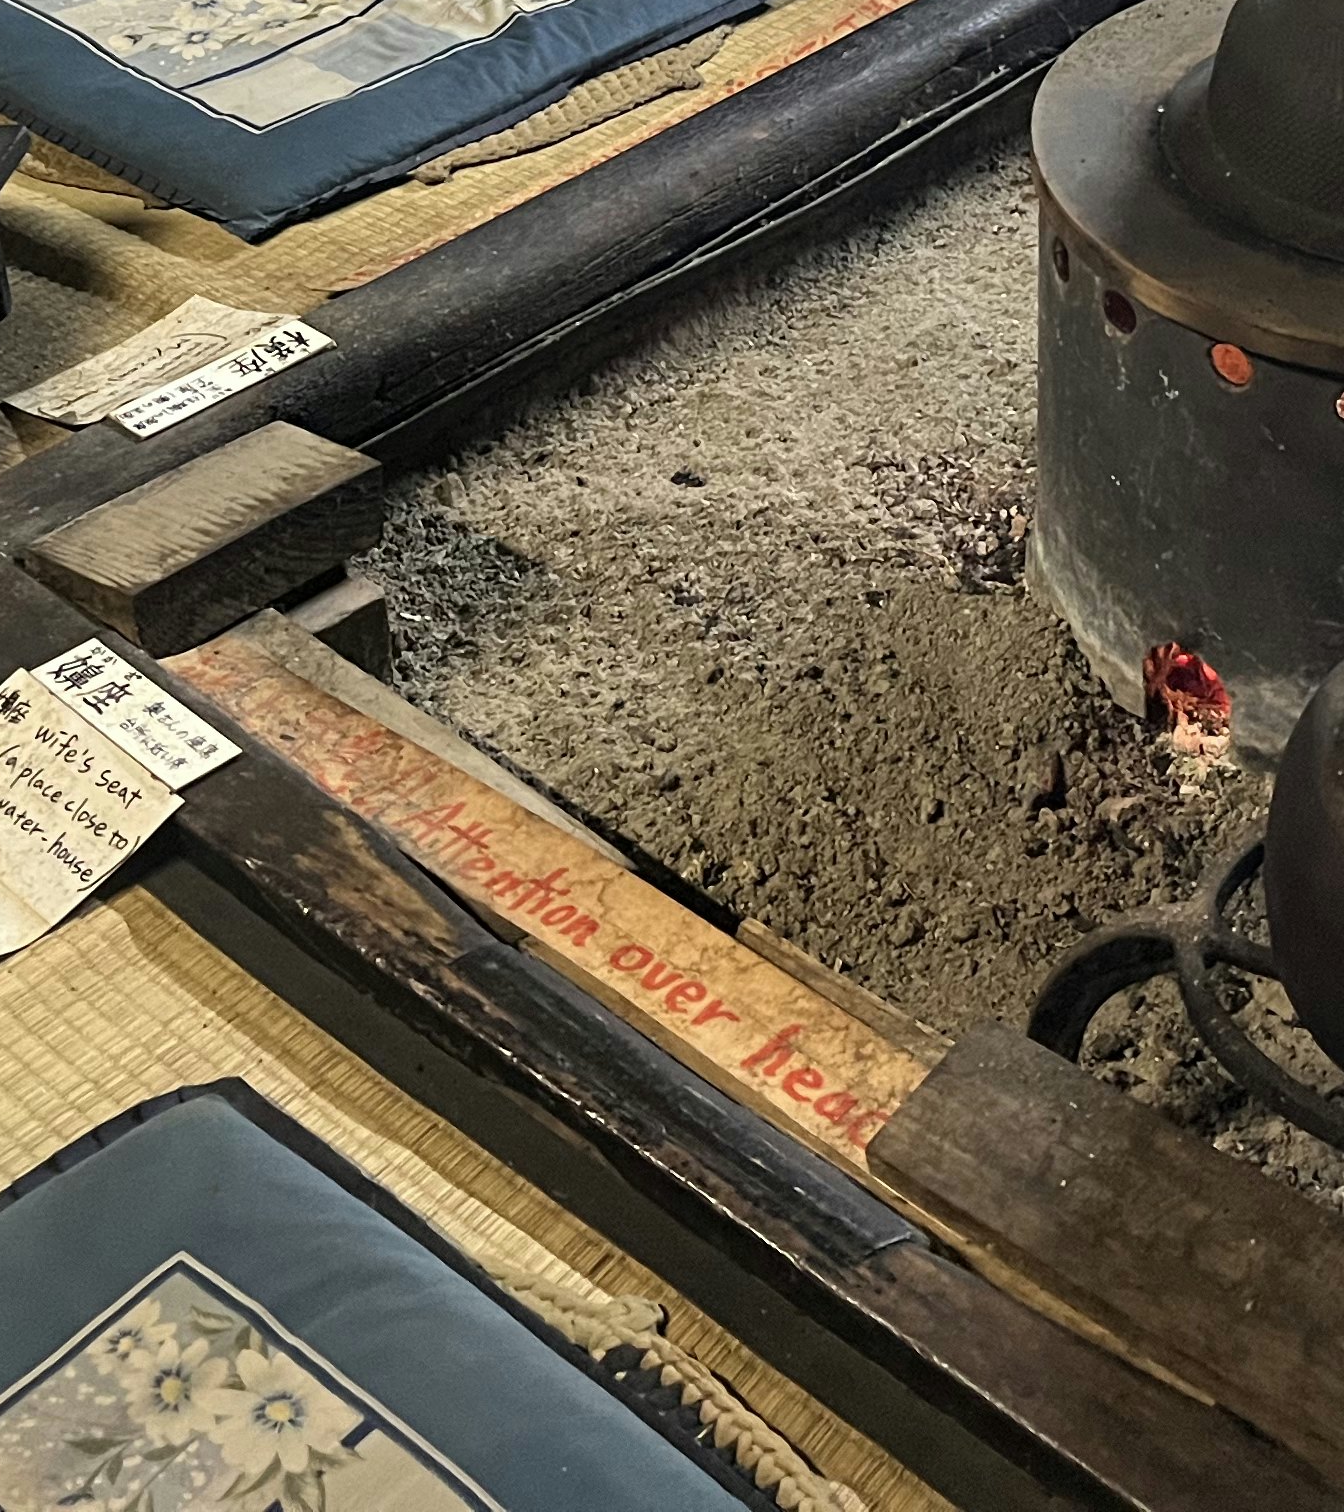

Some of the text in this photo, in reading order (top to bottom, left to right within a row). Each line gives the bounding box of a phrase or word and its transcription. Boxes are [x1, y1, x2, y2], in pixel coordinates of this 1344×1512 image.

[10, 766, 63, 806] place
[65, 798, 106, 838] close
[35, 725, 143, 811] wife's seat
[393, 802, 599, 947] Attention
[610, 943, 741, 1026] over
